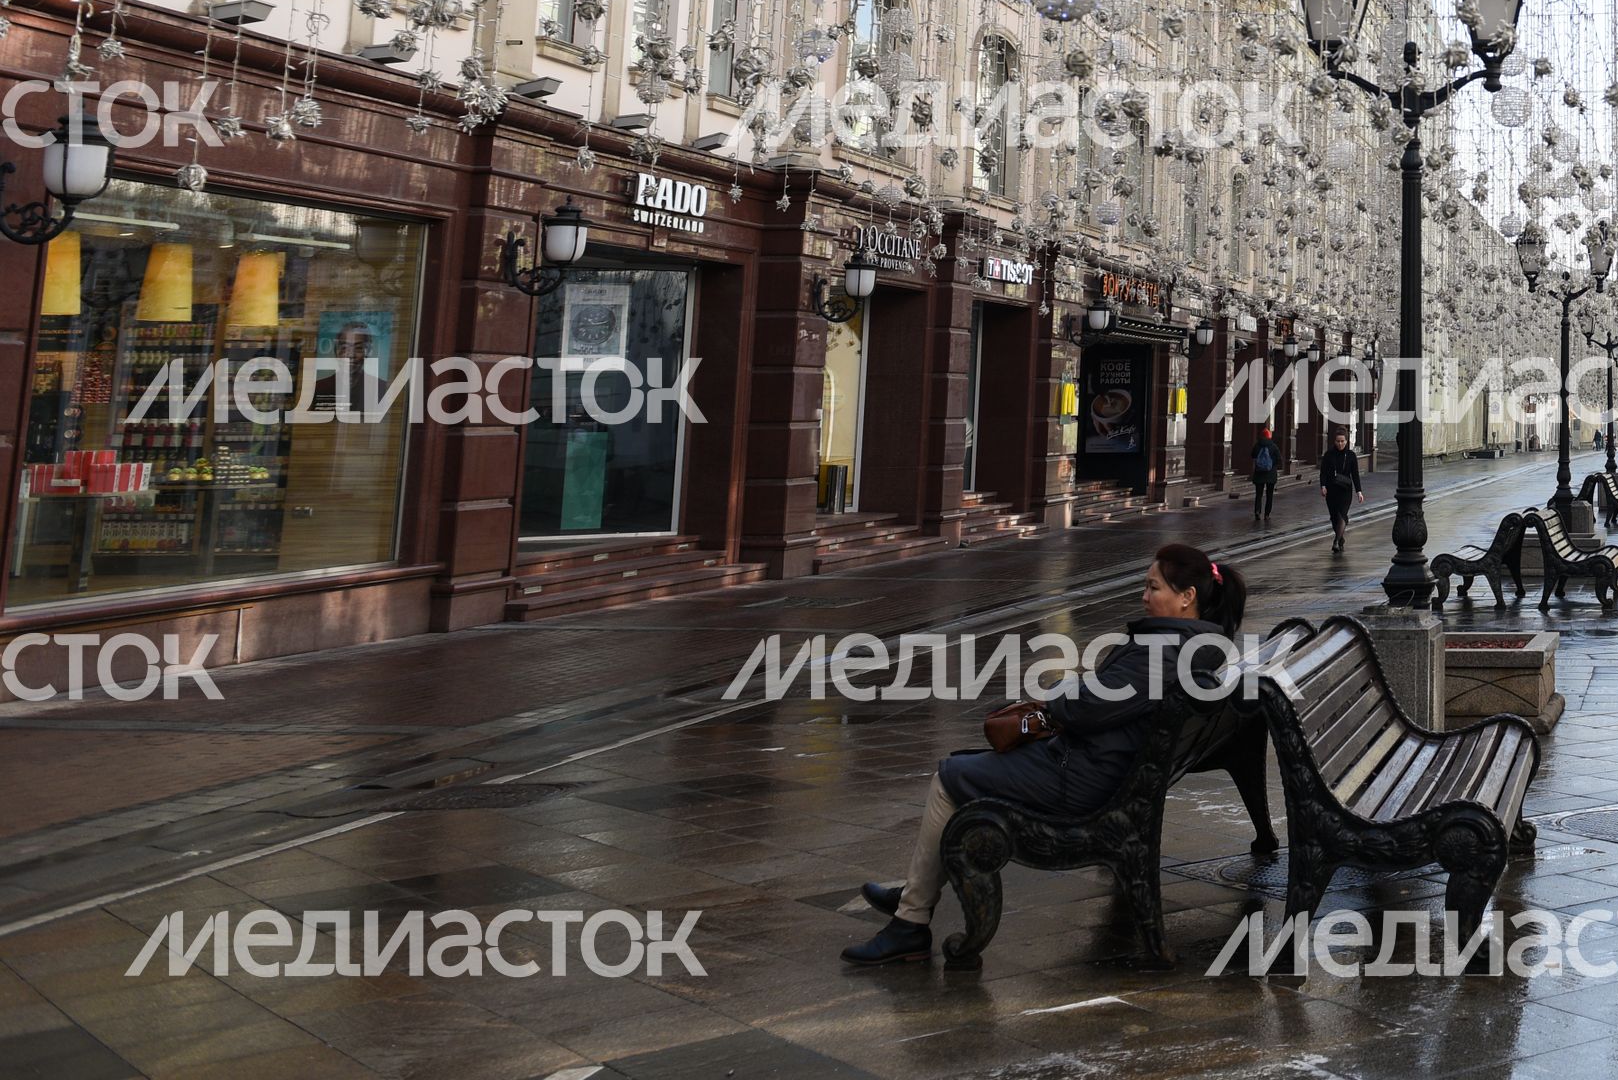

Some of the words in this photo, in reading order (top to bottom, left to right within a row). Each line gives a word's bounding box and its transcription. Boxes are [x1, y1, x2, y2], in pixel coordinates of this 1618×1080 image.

[636, 173, 707, 217] RADO
[633, 209, 705, 233] SWITZERLAND
[880, 257, 911, 273] PROVENC
[1001, 259, 1034, 285] TISSOT
[1100, 362, 1131, 372] КОФЕ
